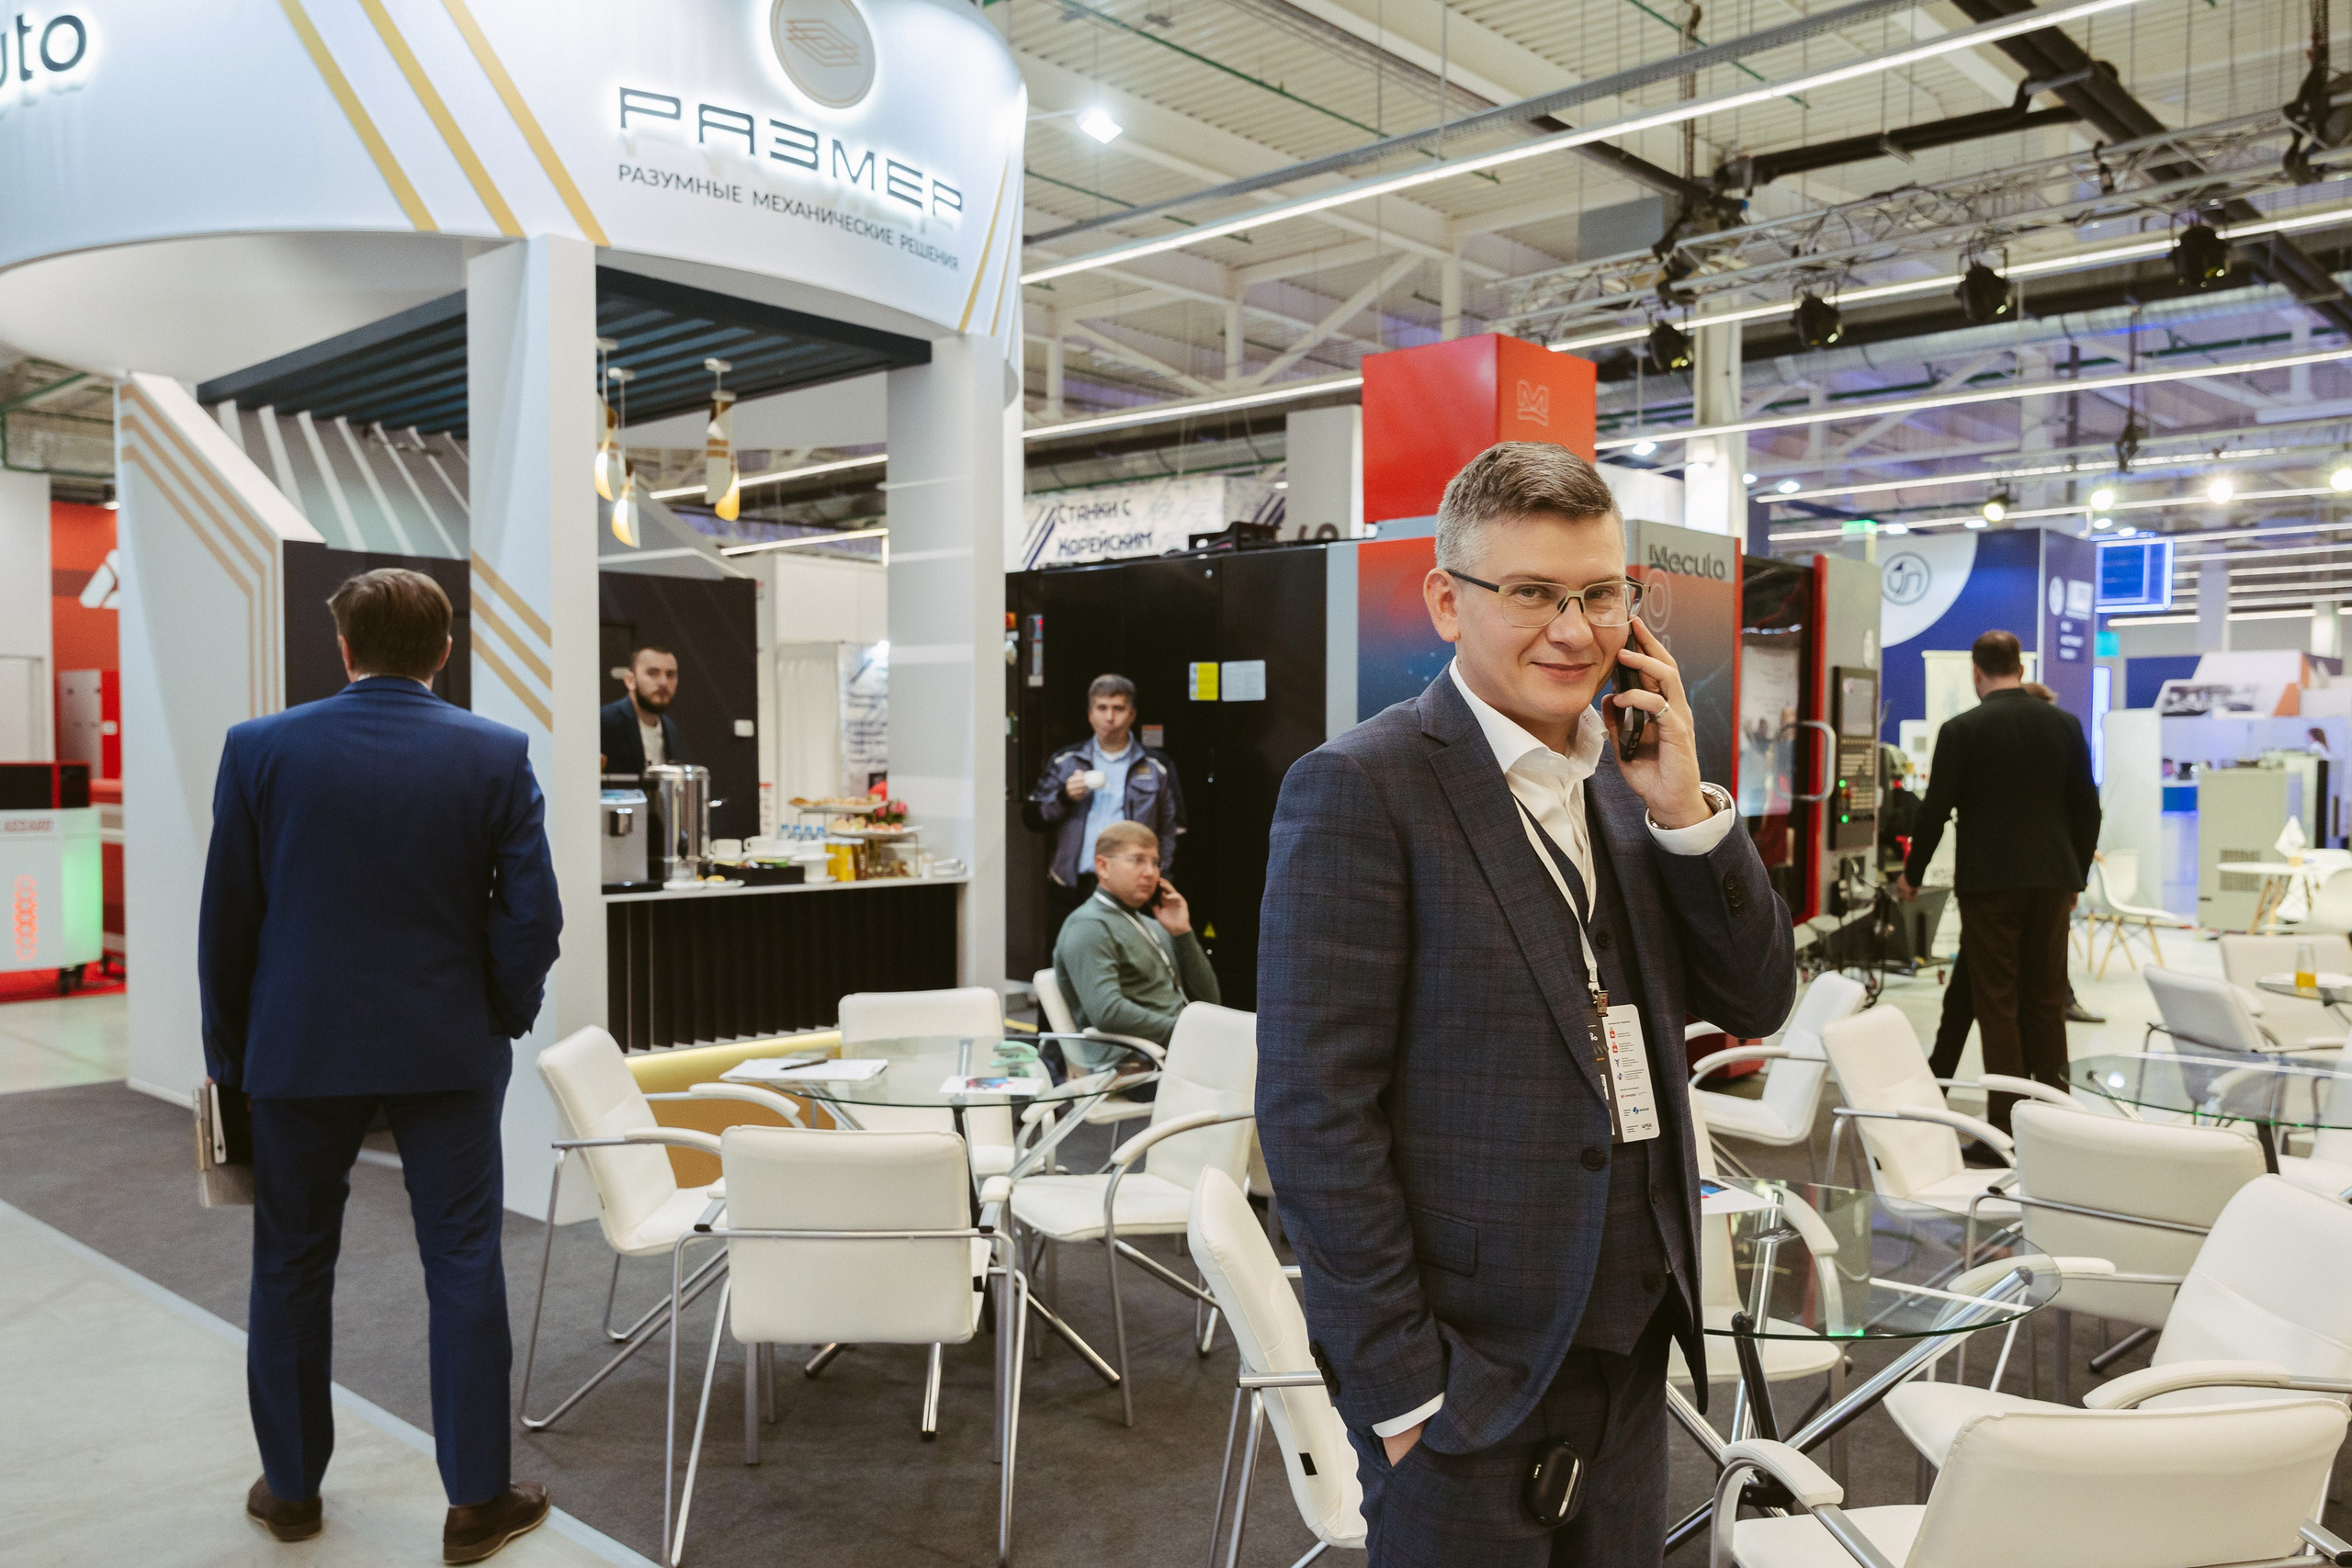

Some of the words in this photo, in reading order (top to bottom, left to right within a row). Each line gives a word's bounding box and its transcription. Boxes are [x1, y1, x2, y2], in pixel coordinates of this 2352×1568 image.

[619, 86, 964, 218] РАЗМЕР
[619, 164, 742, 204] РАЗУМНЫЕ
[752, 189, 895, 247] МЕХАНИЧЕСКИЕ
[899, 234, 959, 272] РЕШЕНИЯ
[1647, 542, 1725, 581] Meculo
